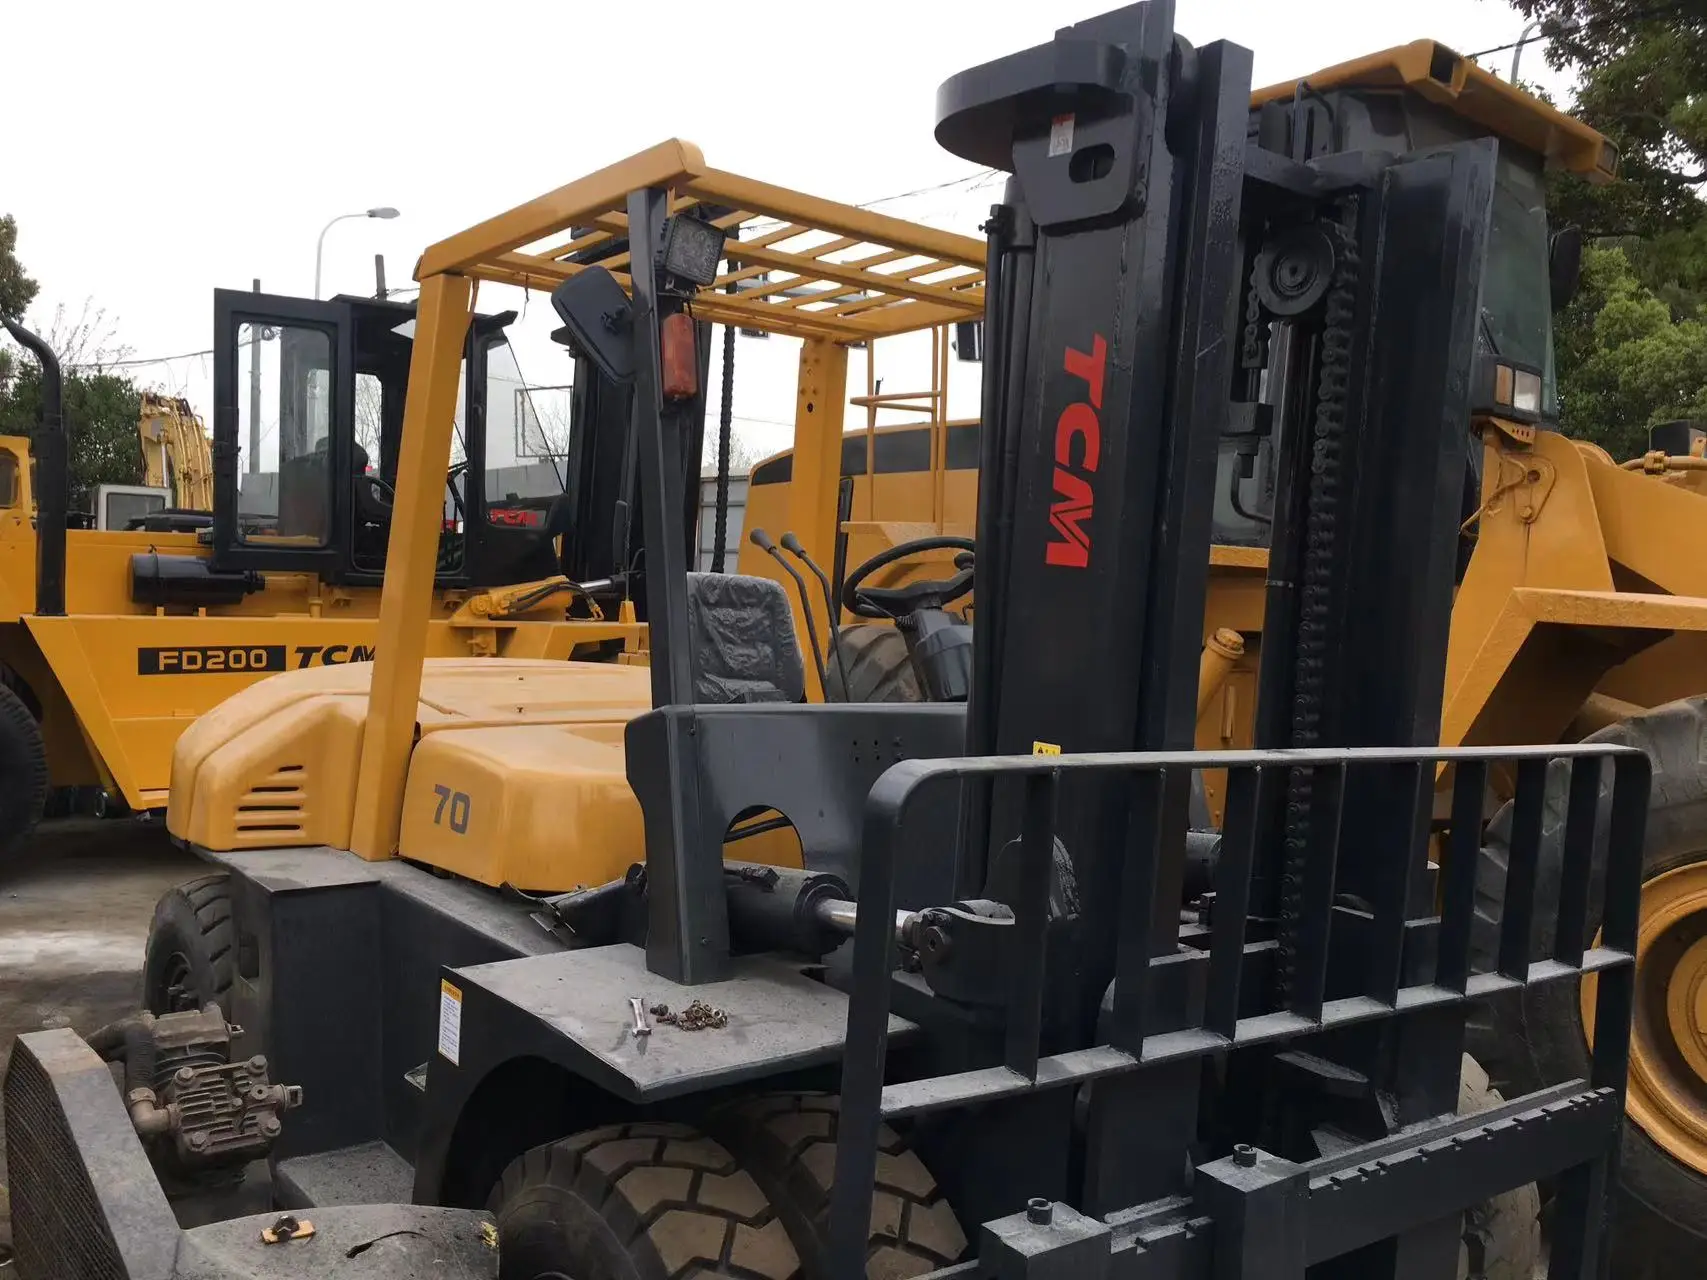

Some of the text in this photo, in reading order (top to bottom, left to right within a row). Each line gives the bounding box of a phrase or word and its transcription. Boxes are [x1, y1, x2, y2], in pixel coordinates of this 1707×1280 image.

[1045, 333, 1107, 568] TCM
[158, 649, 268, 671] FD200
[434, 784, 471, 835] 70
